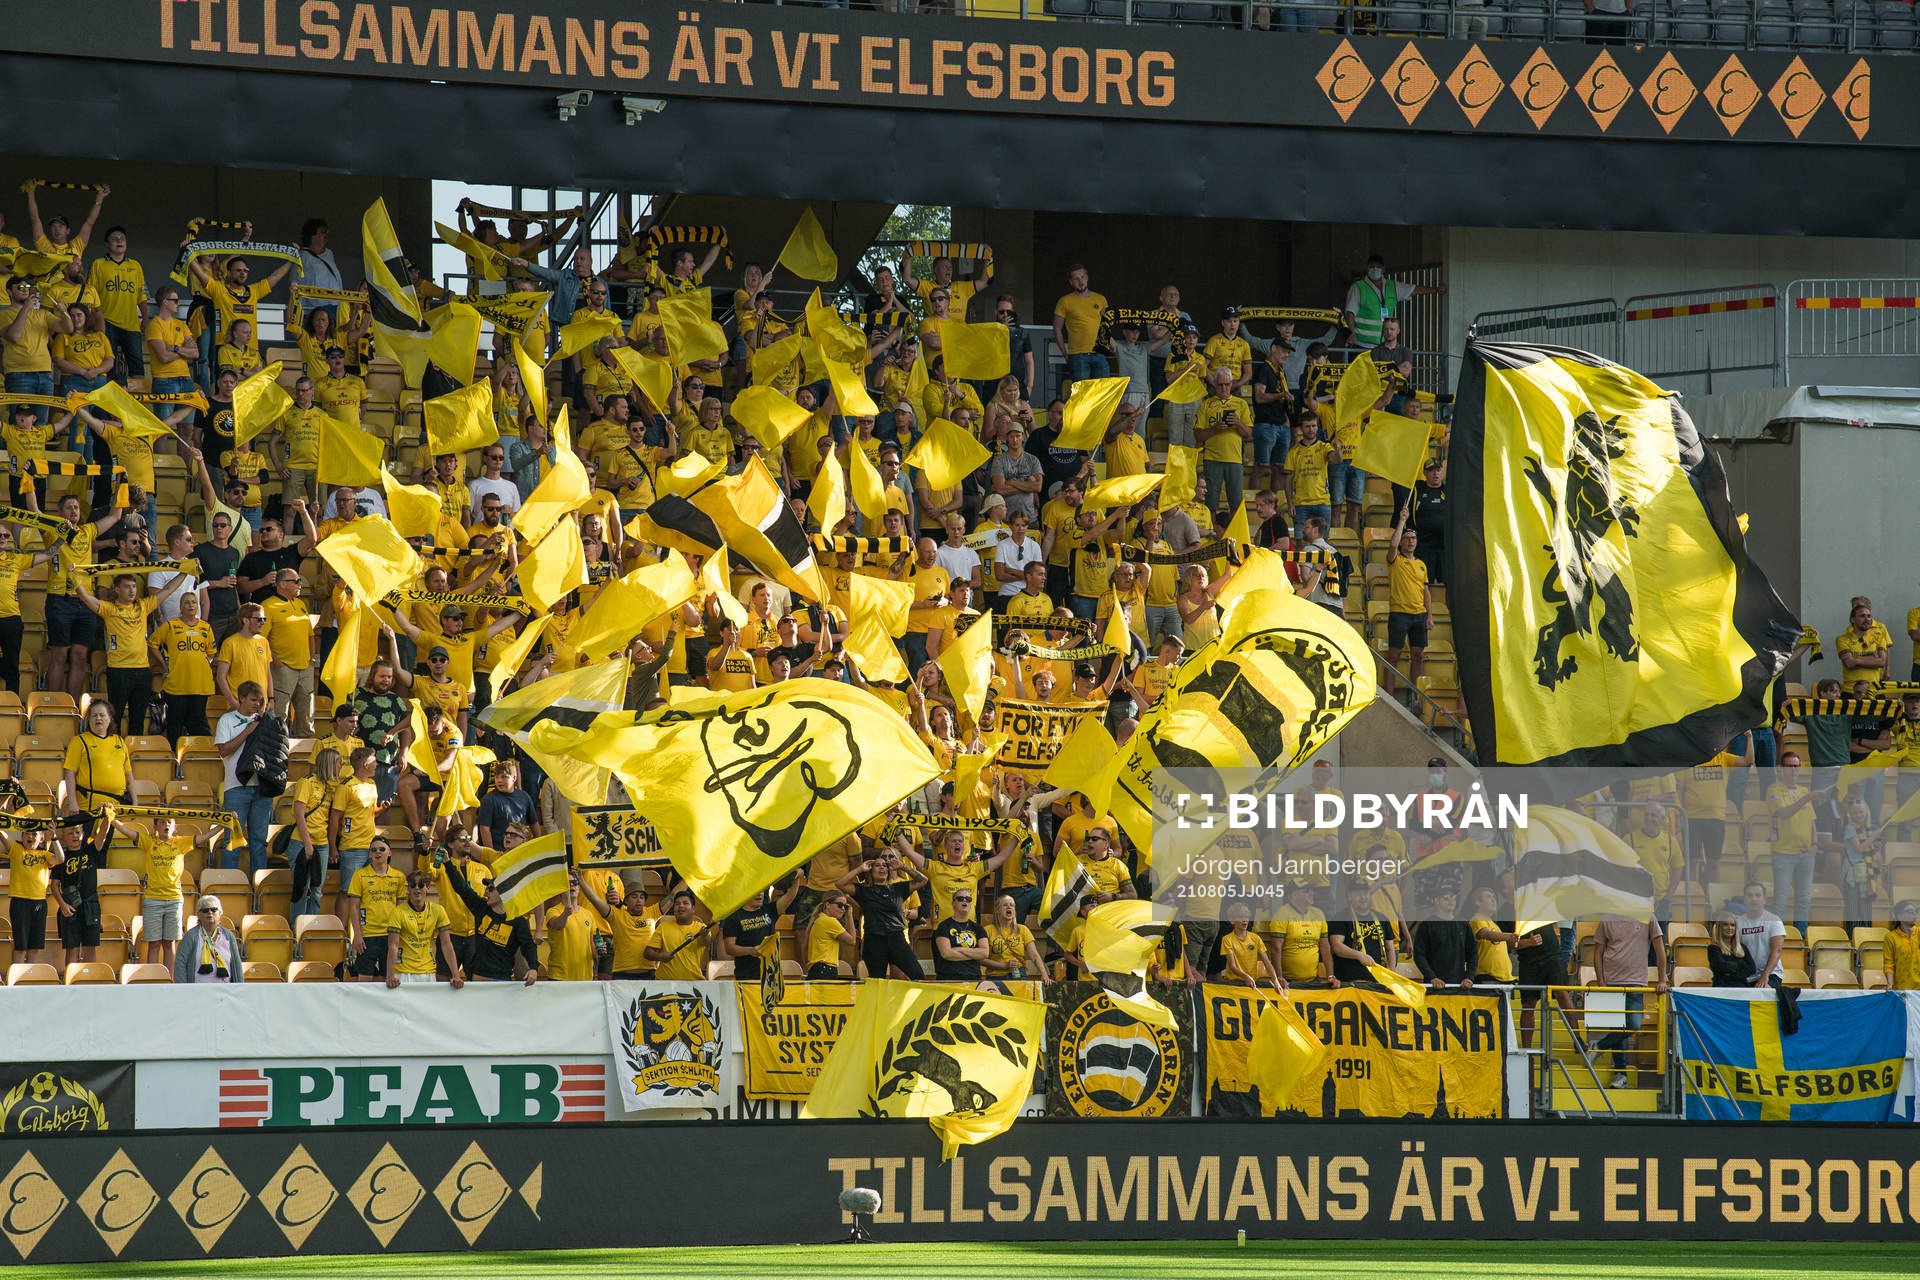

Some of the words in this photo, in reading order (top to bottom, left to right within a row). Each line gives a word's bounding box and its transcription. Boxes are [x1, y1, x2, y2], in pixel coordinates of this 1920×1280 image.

[160, 0, 650, 79] TILLSAMMANS
[669, 11, 753, 86] ÄR
[771, 31, 839, 90] VI
[861, 36, 1175, 107] ELFSBORG
[106, 275, 136, 294] ellos
[1264, 309, 1322, 318] ELFSBORG
[177, 635, 207, 652] ellos
[147, 809, 233, 823] ELFSBORG
[895, 813, 916, 824] 26
[921, 815, 960, 826] JUNI
[965, 817, 1010, 829] 1904
[760, 1013, 847, 1037] GULSVA
[1212, 996, 1495, 1053] GUGANERNA
[778, 1040, 836, 1064] SYST
[645, 1066, 678, 1081] SEKTION
[1335, 1058, 1371, 1080] 1991
[1695, 1065, 1718, 1089] IF
[1735, 1065, 1893, 1097] ELFSBORG
[261, 1064, 561, 1127] PEAB
[828, 1156, 1369, 1224] TILLSAMMANS
[1390, 1140, 1484, 1221] ÄR
[1504, 1157, 1580, 1221] VI
[1604, 1157, 1920, 1224] ELFSBOR
